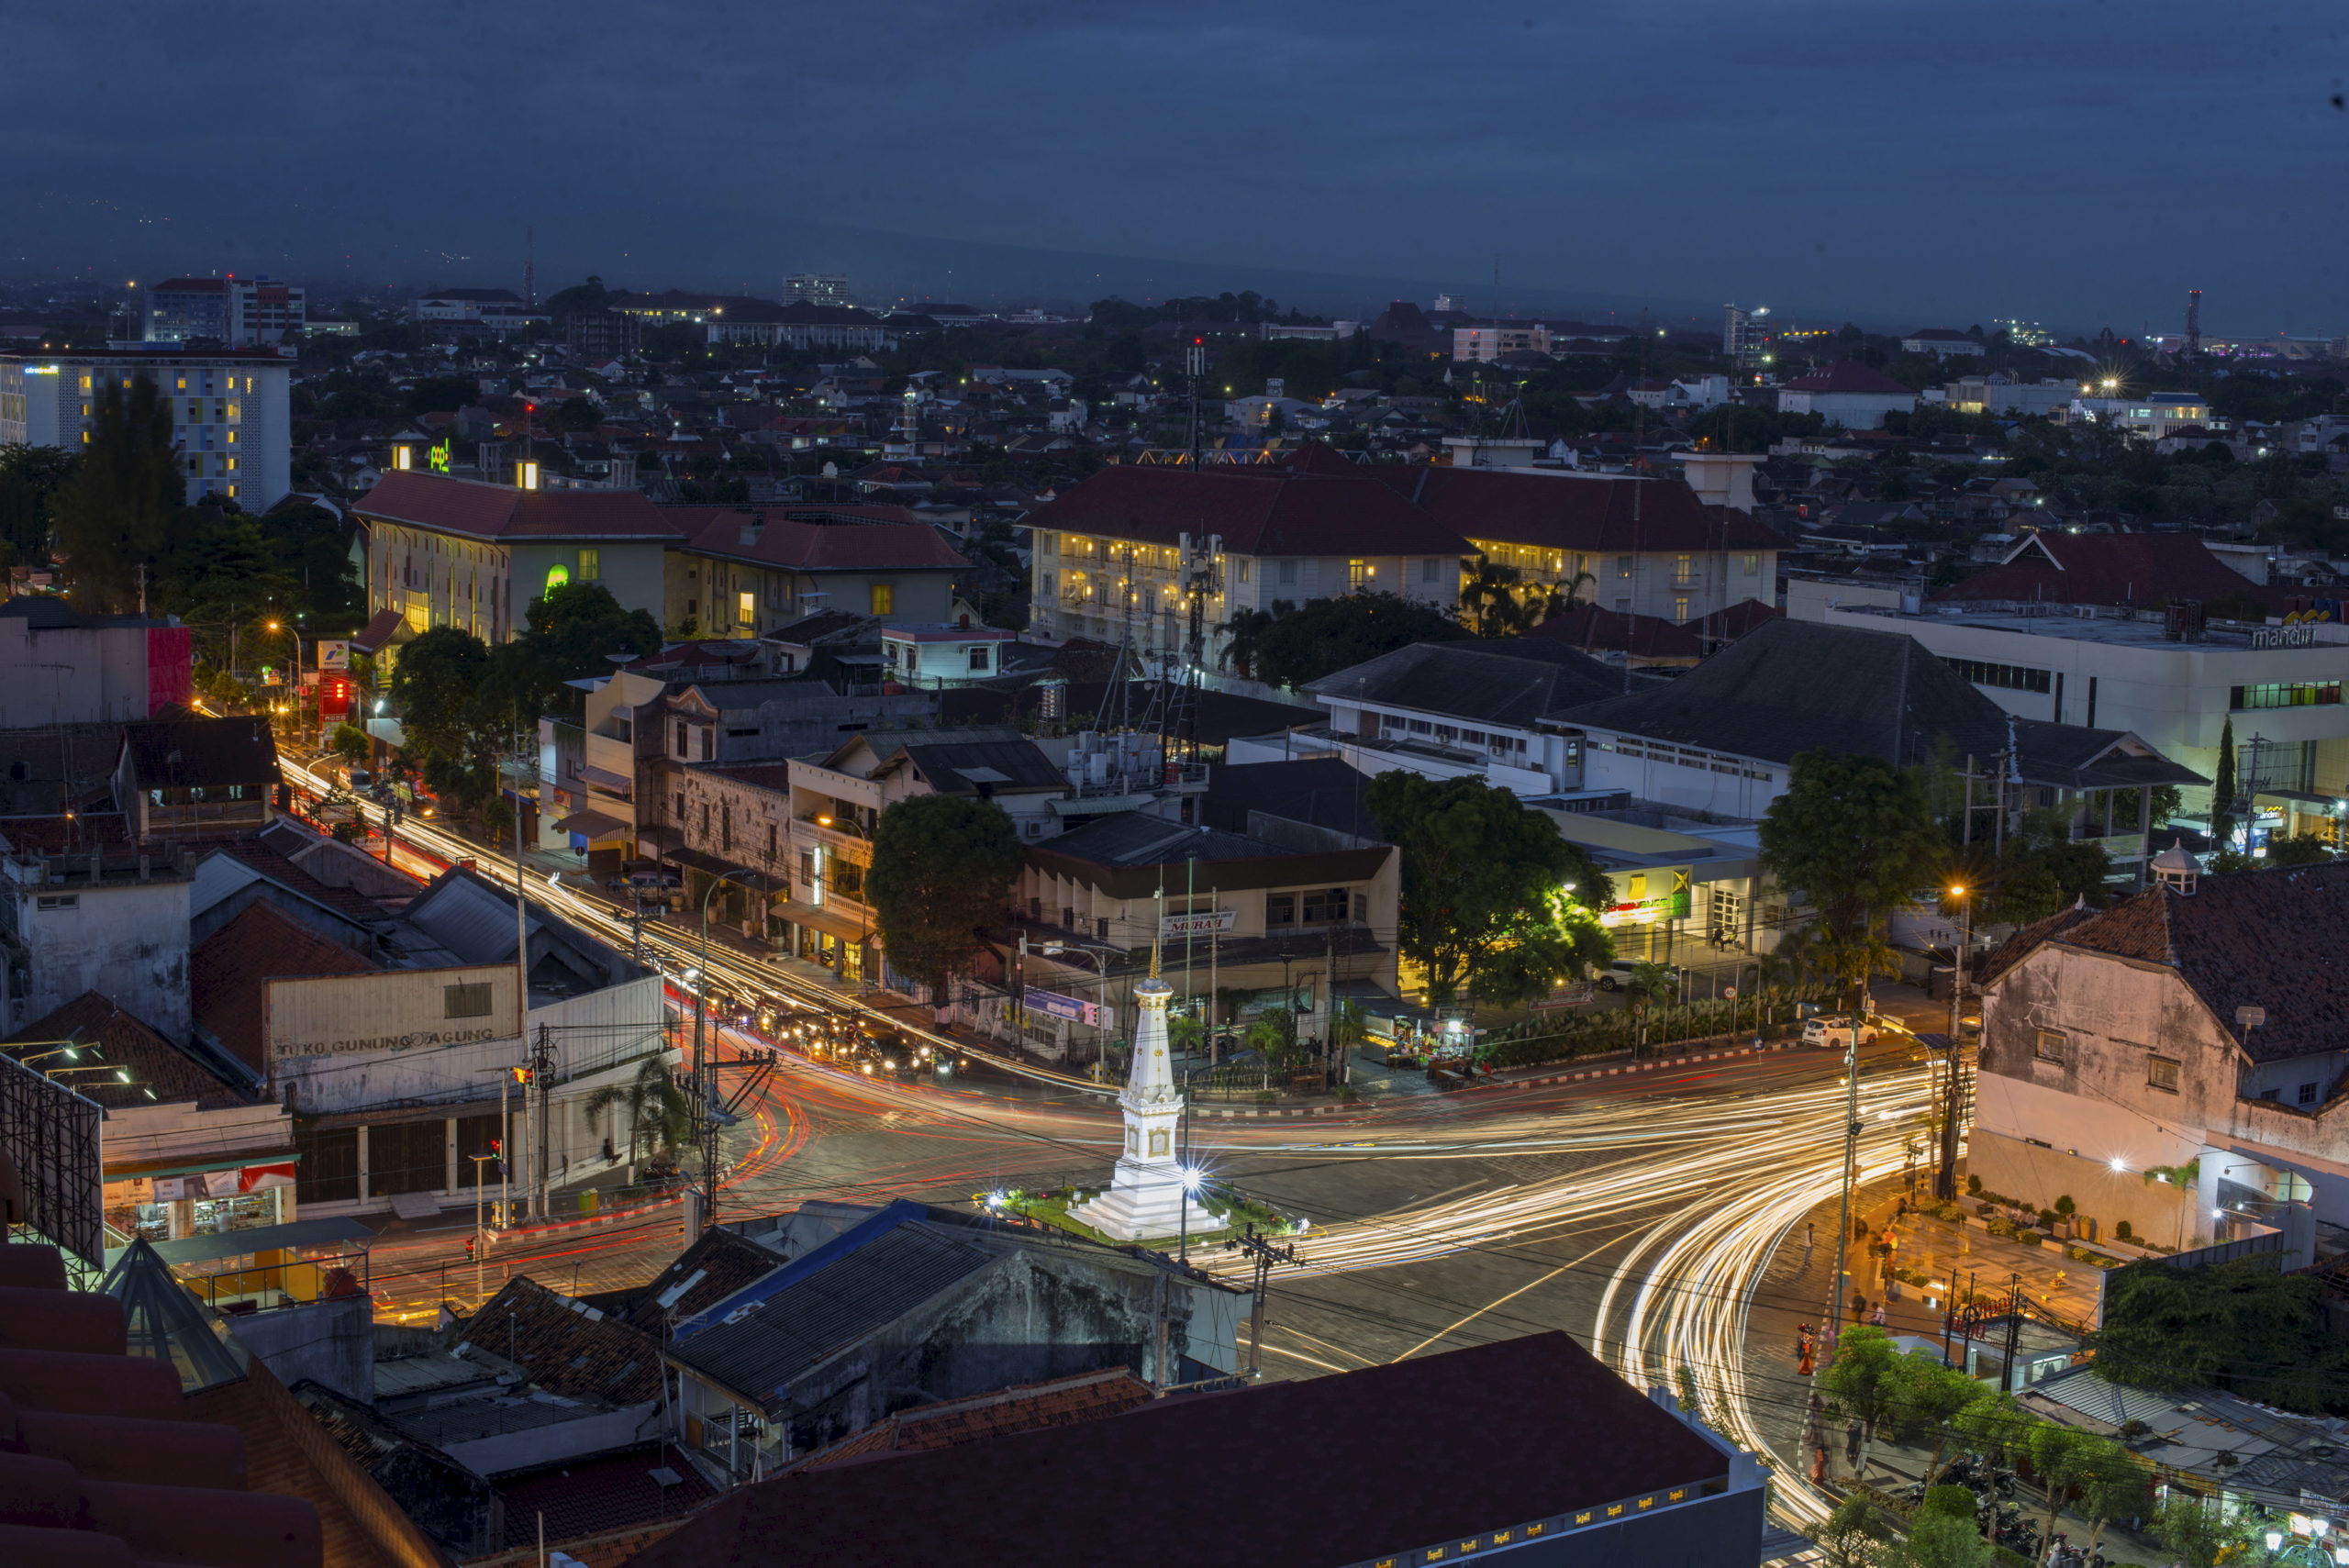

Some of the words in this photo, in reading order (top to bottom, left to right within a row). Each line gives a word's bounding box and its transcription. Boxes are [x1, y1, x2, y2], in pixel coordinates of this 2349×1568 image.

[2253, 620, 2317, 648] mandiri
[1171, 919, 1223, 933] MURAH
[332, 1035, 411, 1052] GUNUNG
[428, 1029, 494, 1044] AGUNG
